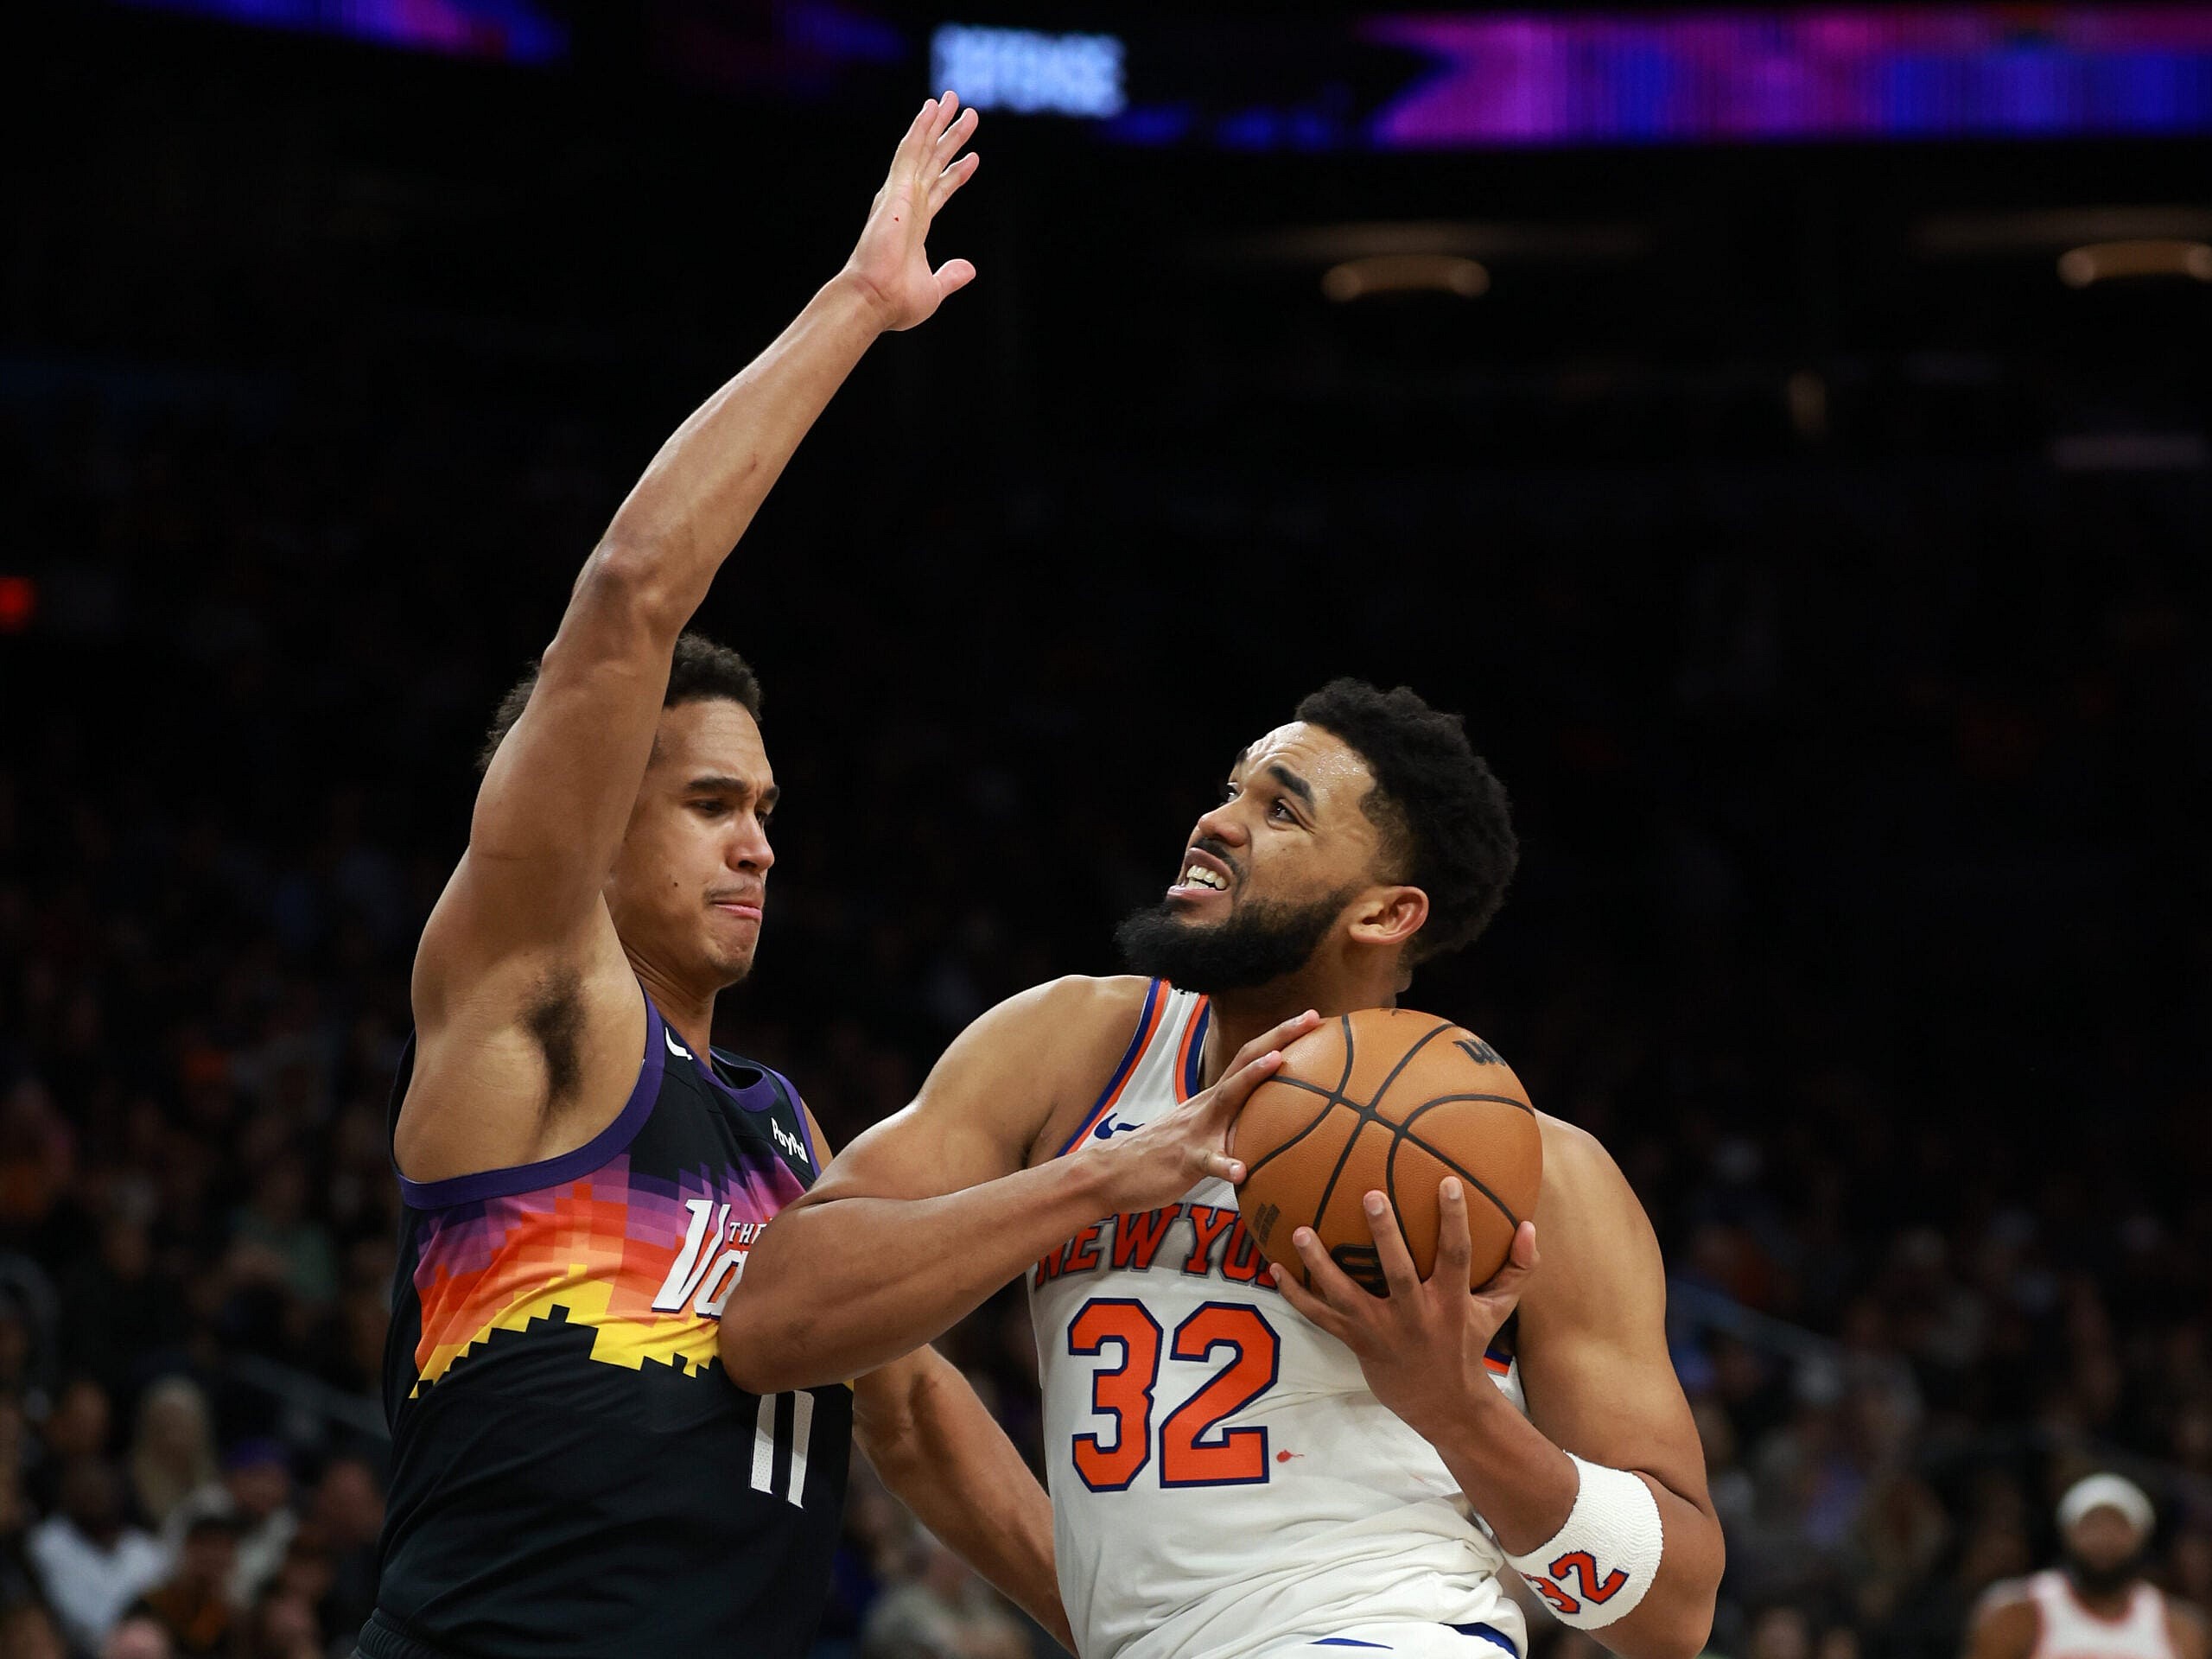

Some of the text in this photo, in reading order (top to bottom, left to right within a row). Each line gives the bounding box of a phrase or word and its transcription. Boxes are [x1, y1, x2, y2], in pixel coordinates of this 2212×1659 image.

[771, 1116, 810, 1164] PayPal
[1181, 1203, 1281, 1294] YO
[1067, 1298, 1281, 1493] 32
[748, 1389, 815, 1510] 11
[1519, 1549, 1630, 1614] 32
